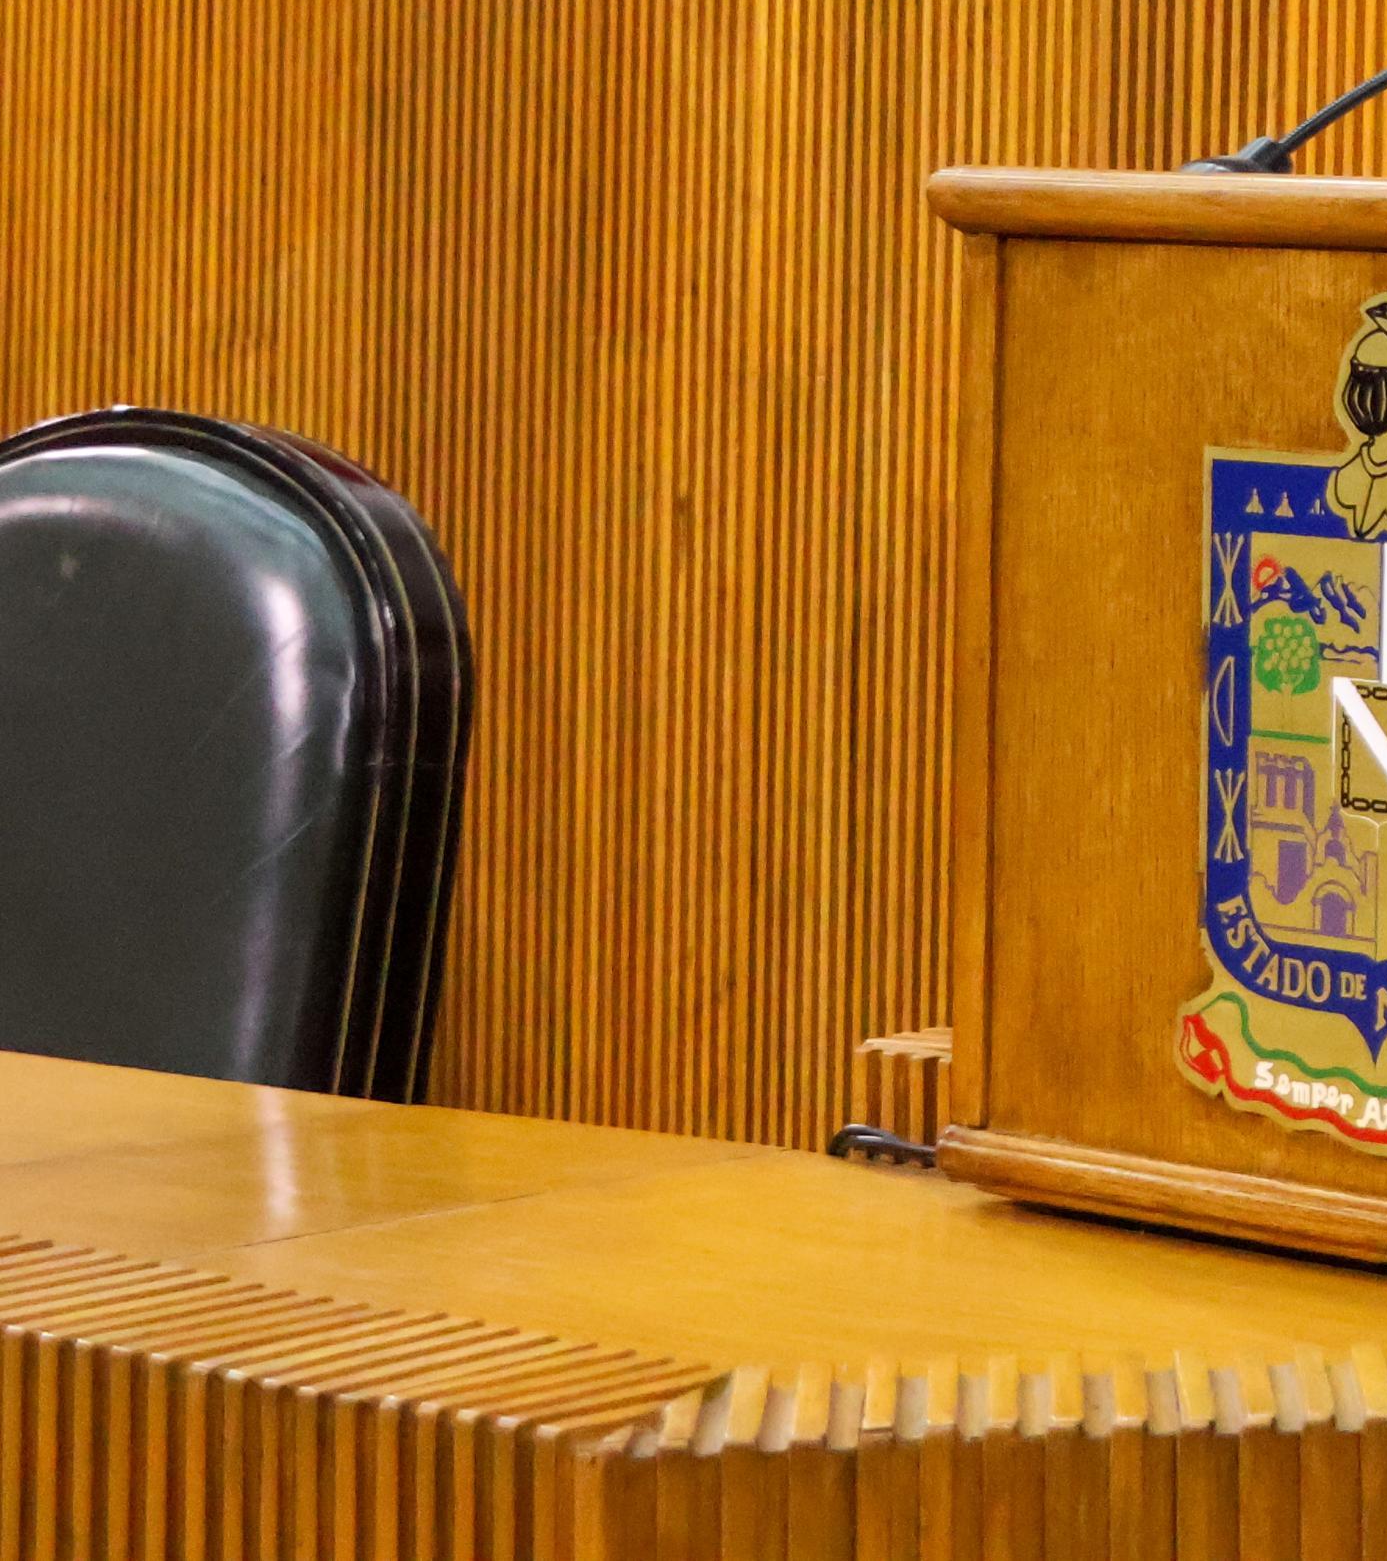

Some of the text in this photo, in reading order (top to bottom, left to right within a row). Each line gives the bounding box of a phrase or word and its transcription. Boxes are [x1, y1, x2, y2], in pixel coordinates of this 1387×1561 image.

[1216, 894, 1331, 1003] ESTADO
[1340, 971, 1367, 1001] DE
[1254, 1060, 1354, 1117] Semper
